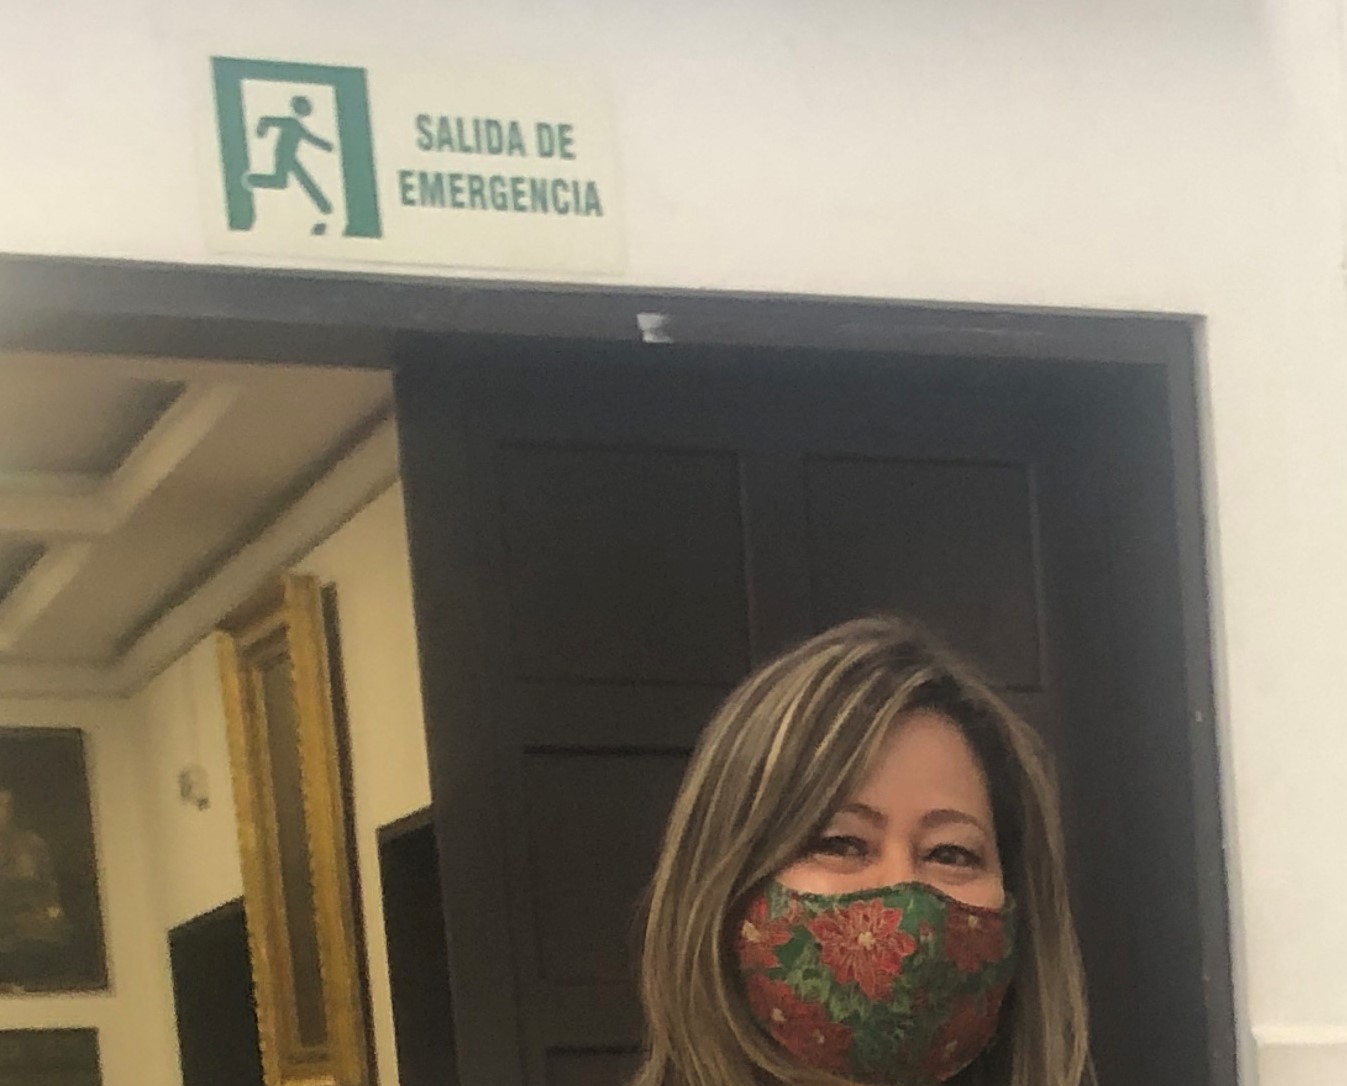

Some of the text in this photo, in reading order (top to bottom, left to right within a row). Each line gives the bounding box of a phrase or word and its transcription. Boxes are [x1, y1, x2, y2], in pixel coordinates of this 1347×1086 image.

[415, 113, 577, 160] SALIDA DE
[397, 169, 604, 217] EMERGENCIA
